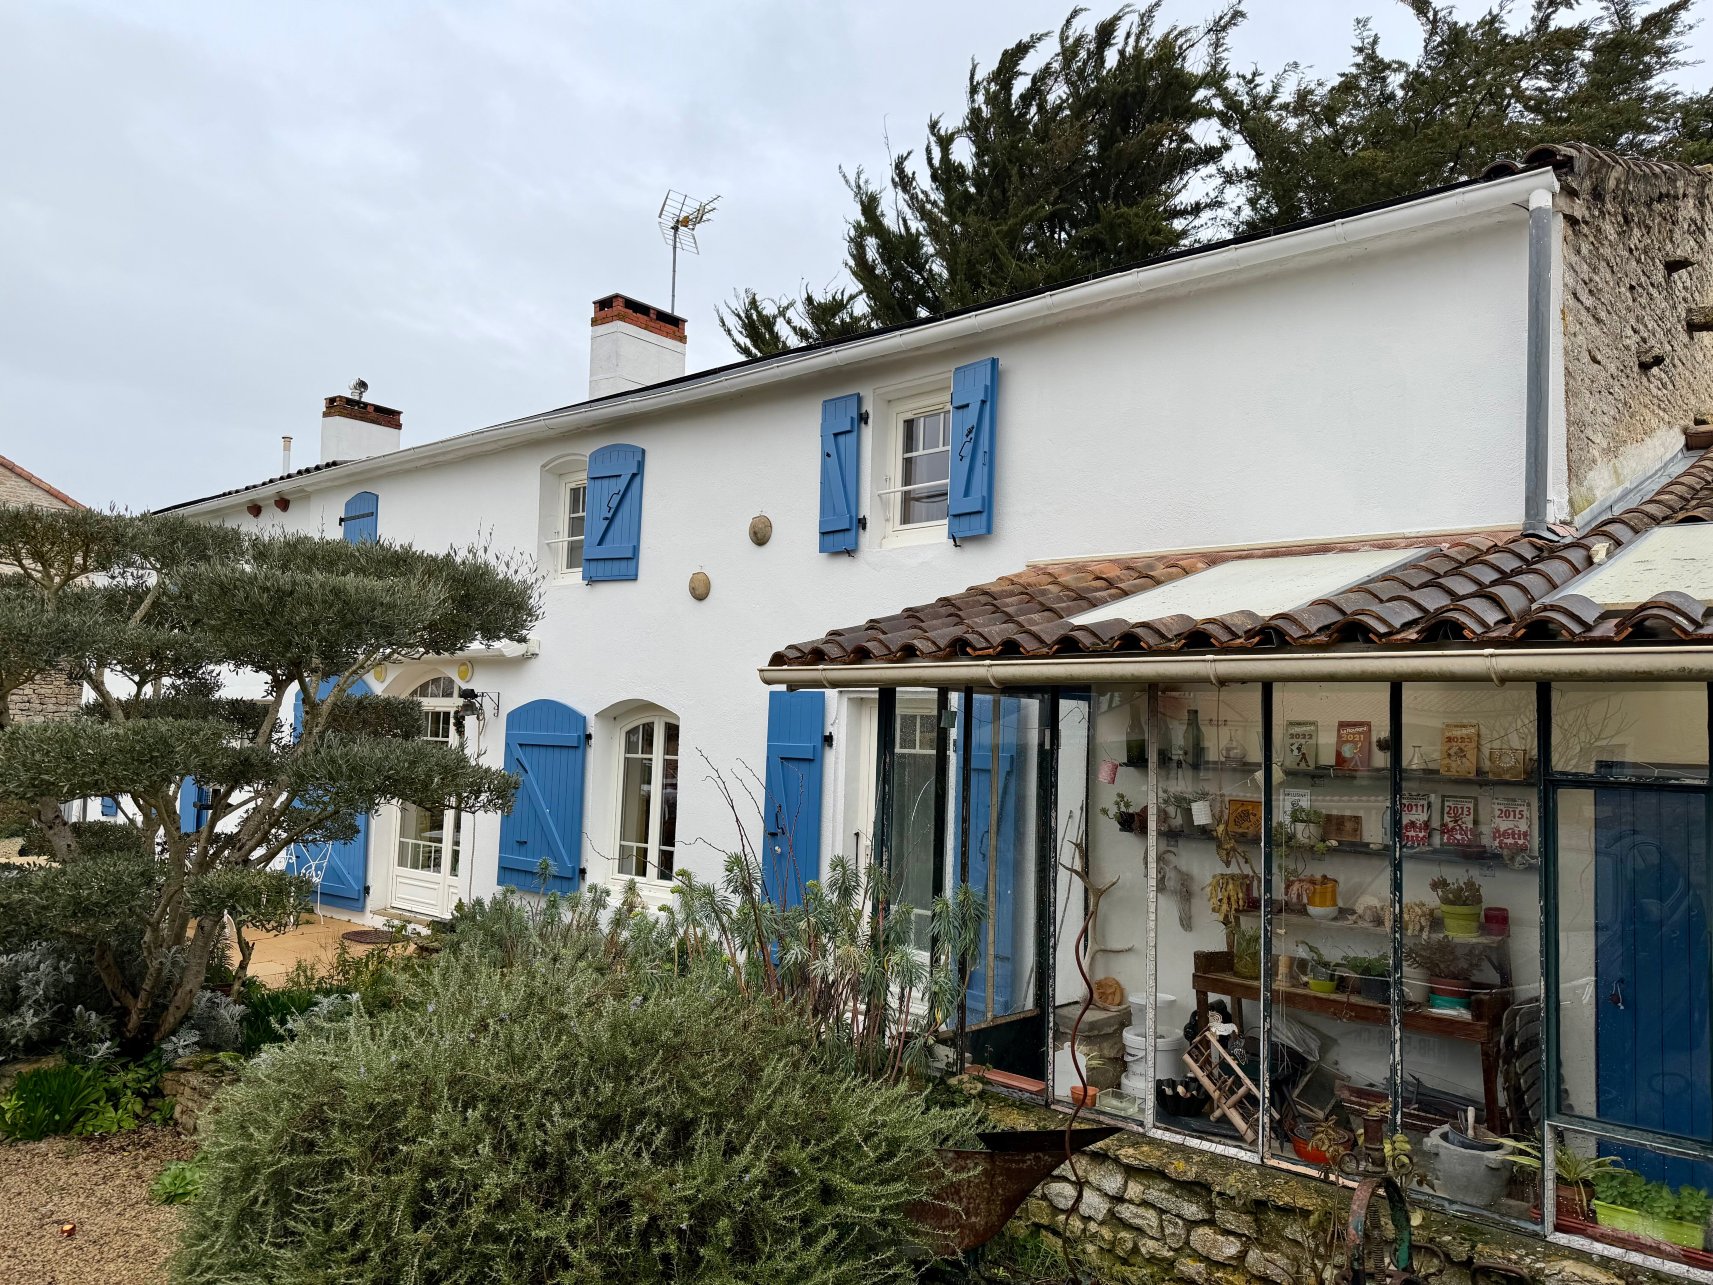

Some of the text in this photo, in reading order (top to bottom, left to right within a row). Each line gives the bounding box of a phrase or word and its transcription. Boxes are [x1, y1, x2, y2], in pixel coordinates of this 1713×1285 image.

[1401, 802, 1425, 814] 2011
[1446, 805, 1472, 817] 2013
[1497, 808, 1525, 820] 2015
